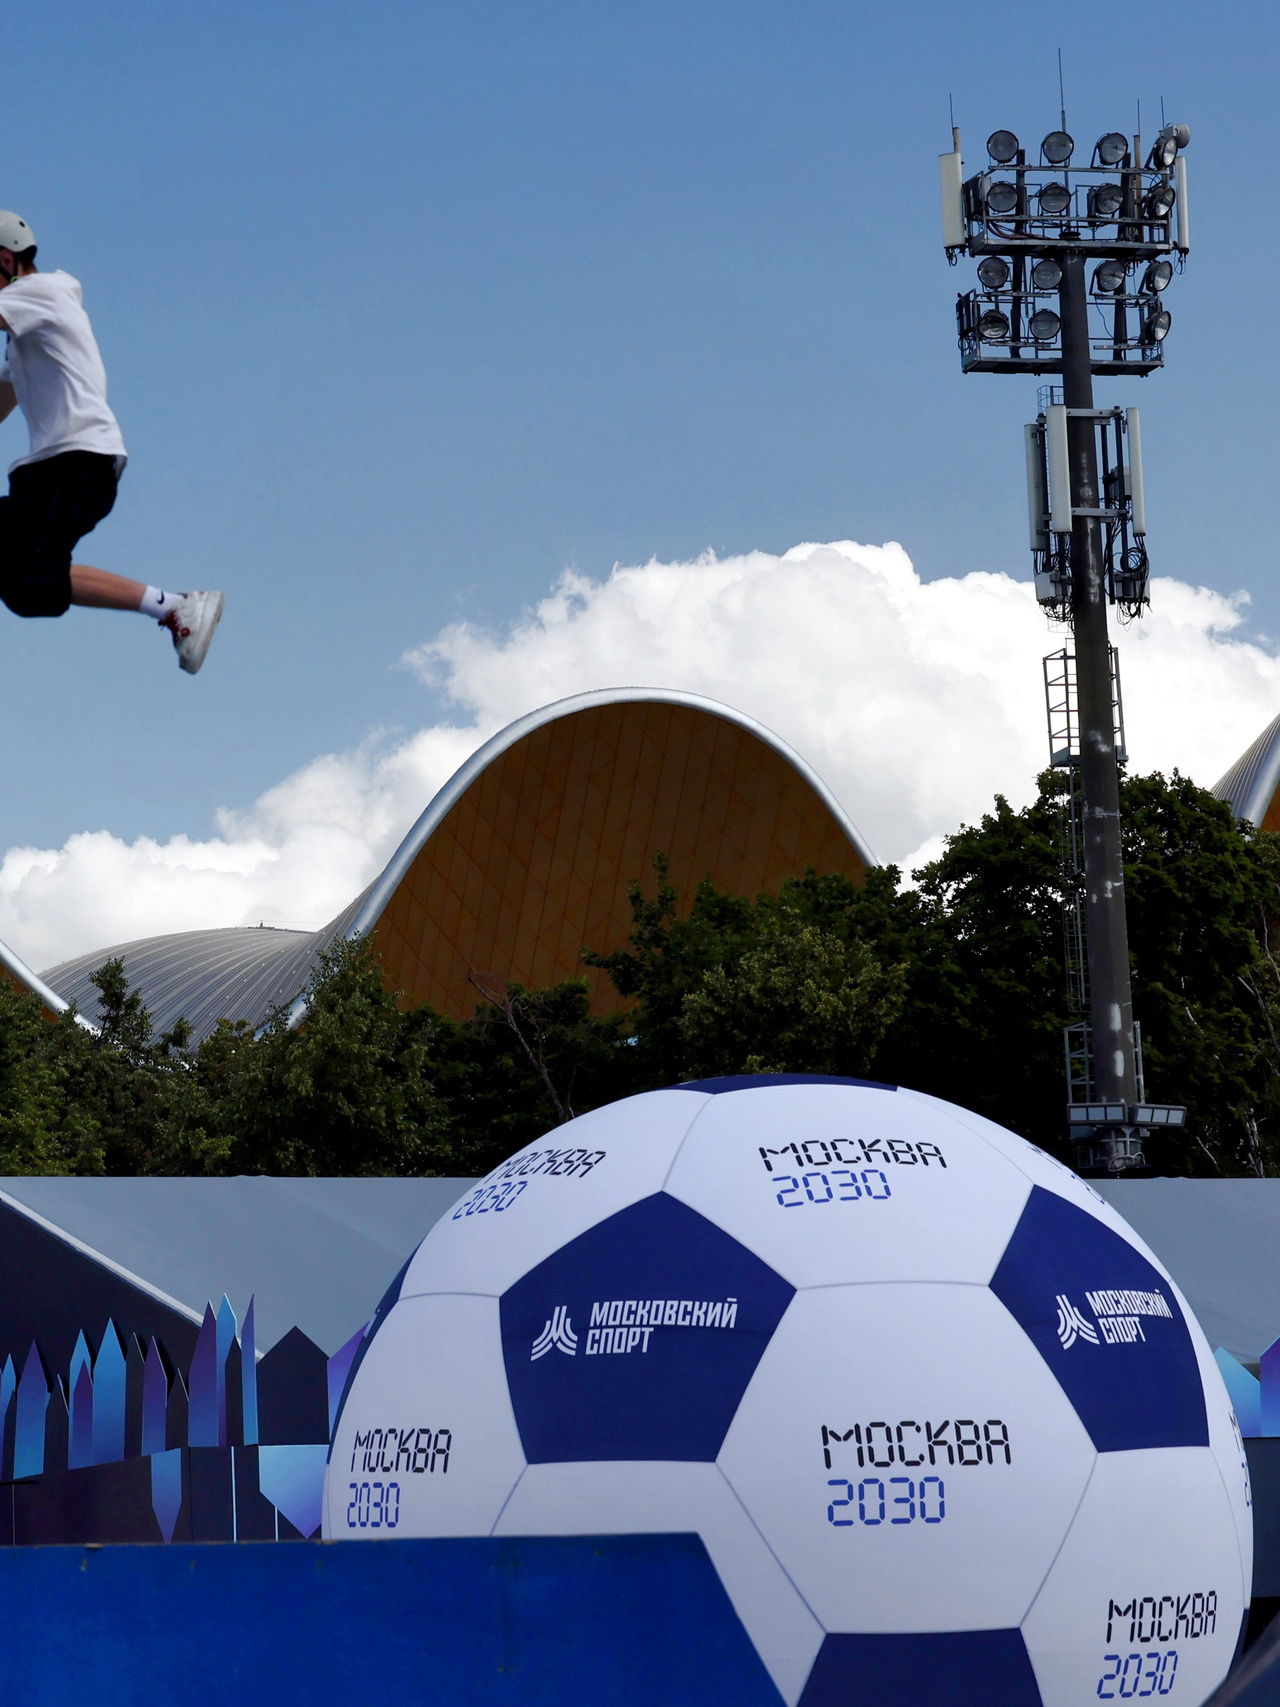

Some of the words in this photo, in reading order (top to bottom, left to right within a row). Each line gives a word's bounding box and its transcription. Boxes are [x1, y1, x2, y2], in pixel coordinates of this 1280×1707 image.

[483, 1149, 606, 1184] МОСКВА
[758, 1138, 947, 1171] МОСКВА
[452, 1181, 528, 1220] 2030
[772, 1169, 891, 1208] 2030
[589, 1297, 738, 1328] МОСКОВСКИЙ
[1084, 1288, 1173, 1318] МОСКОВСКИЙ
[585, 1327, 654, 1355] СПОРТ
[1097, 1317, 1146, 1344] СПОРТ
[350, 1428, 452, 1474] МОСКВА
[821, 1420, 1012, 1469] МОСКВА
[347, 1482, 400, 1528] 2030
[827, 1476, 946, 1527] 2030
[1106, 1590, 1217, 1644] МОСКВА
[1096, 1651, 1179, 1699] 2030
